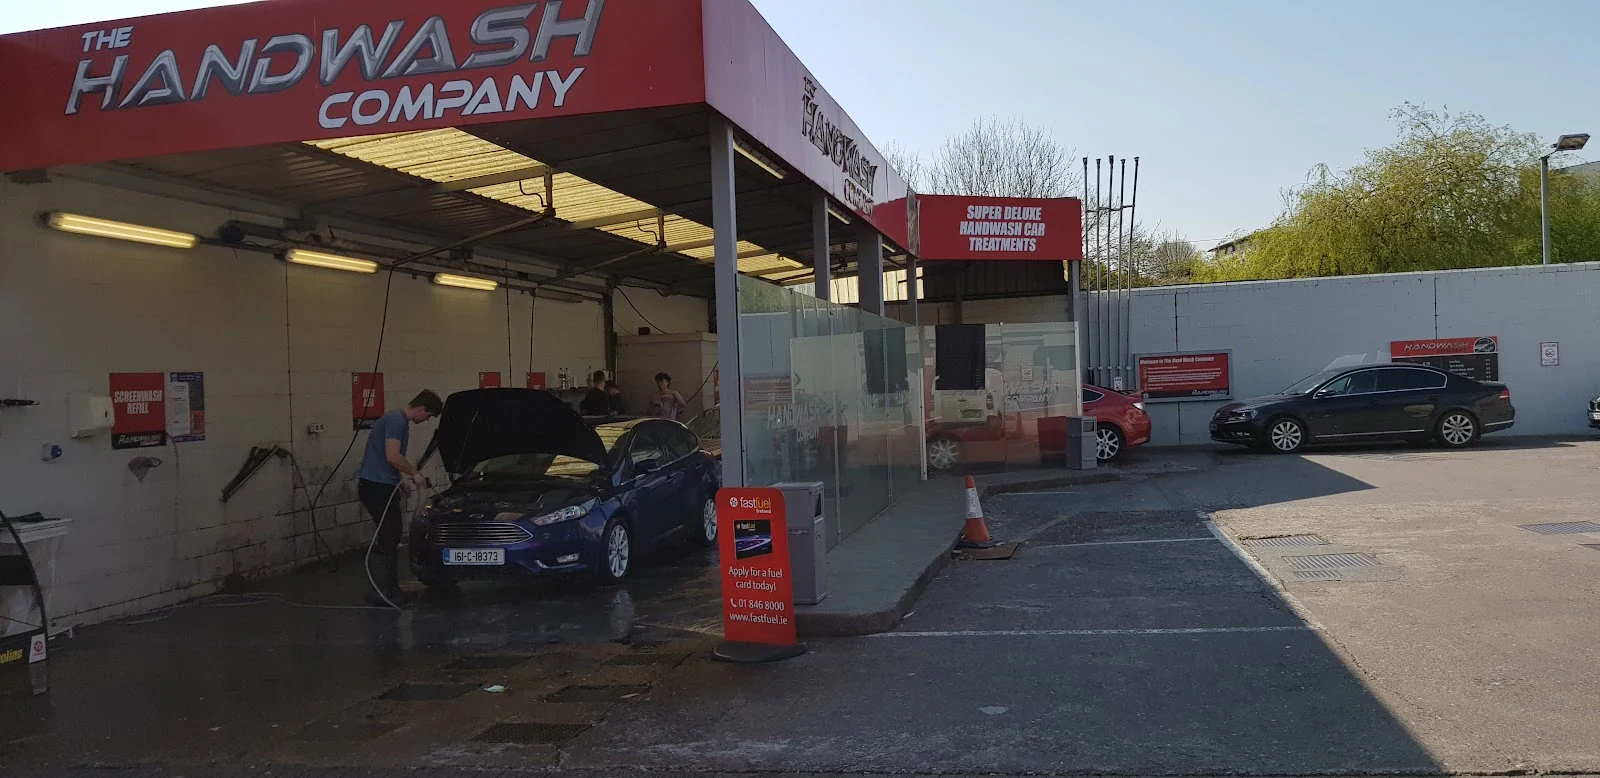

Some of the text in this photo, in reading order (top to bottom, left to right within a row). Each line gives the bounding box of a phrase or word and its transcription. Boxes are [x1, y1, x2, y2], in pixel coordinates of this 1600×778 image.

[81, 25, 134, 53] THE
[65, 0, 605, 115] HANDWASH
[318, 66, 586, 129] COMPANY
[802, 94, 878, 196] HANDWASH
[967, 205, 1042, 221] SUPER DELUXE
[959, 220, 1045, 237] HANDWASH CAR
[969, 237, 1036, 252] TREATMENTS
[1403, 342, 1468, 351] HANDWASH
[113, 390, 163, 403] SCREENWASH
[127, 402, 149, 415] REFILL
[740, 496, 771, 509] fastfuel
[454, 551, 498, 562] 161-C-18373
[728, 566, 749, 578] Apply
[750, 566, 761, 577] for
[768, 567, 783, 578] fuel
[736, 580, 777, 592] card today!
[738, 598, 785, 611] 01 846 8000
[729, 612, 788, 625] www.fastfuel.ie
